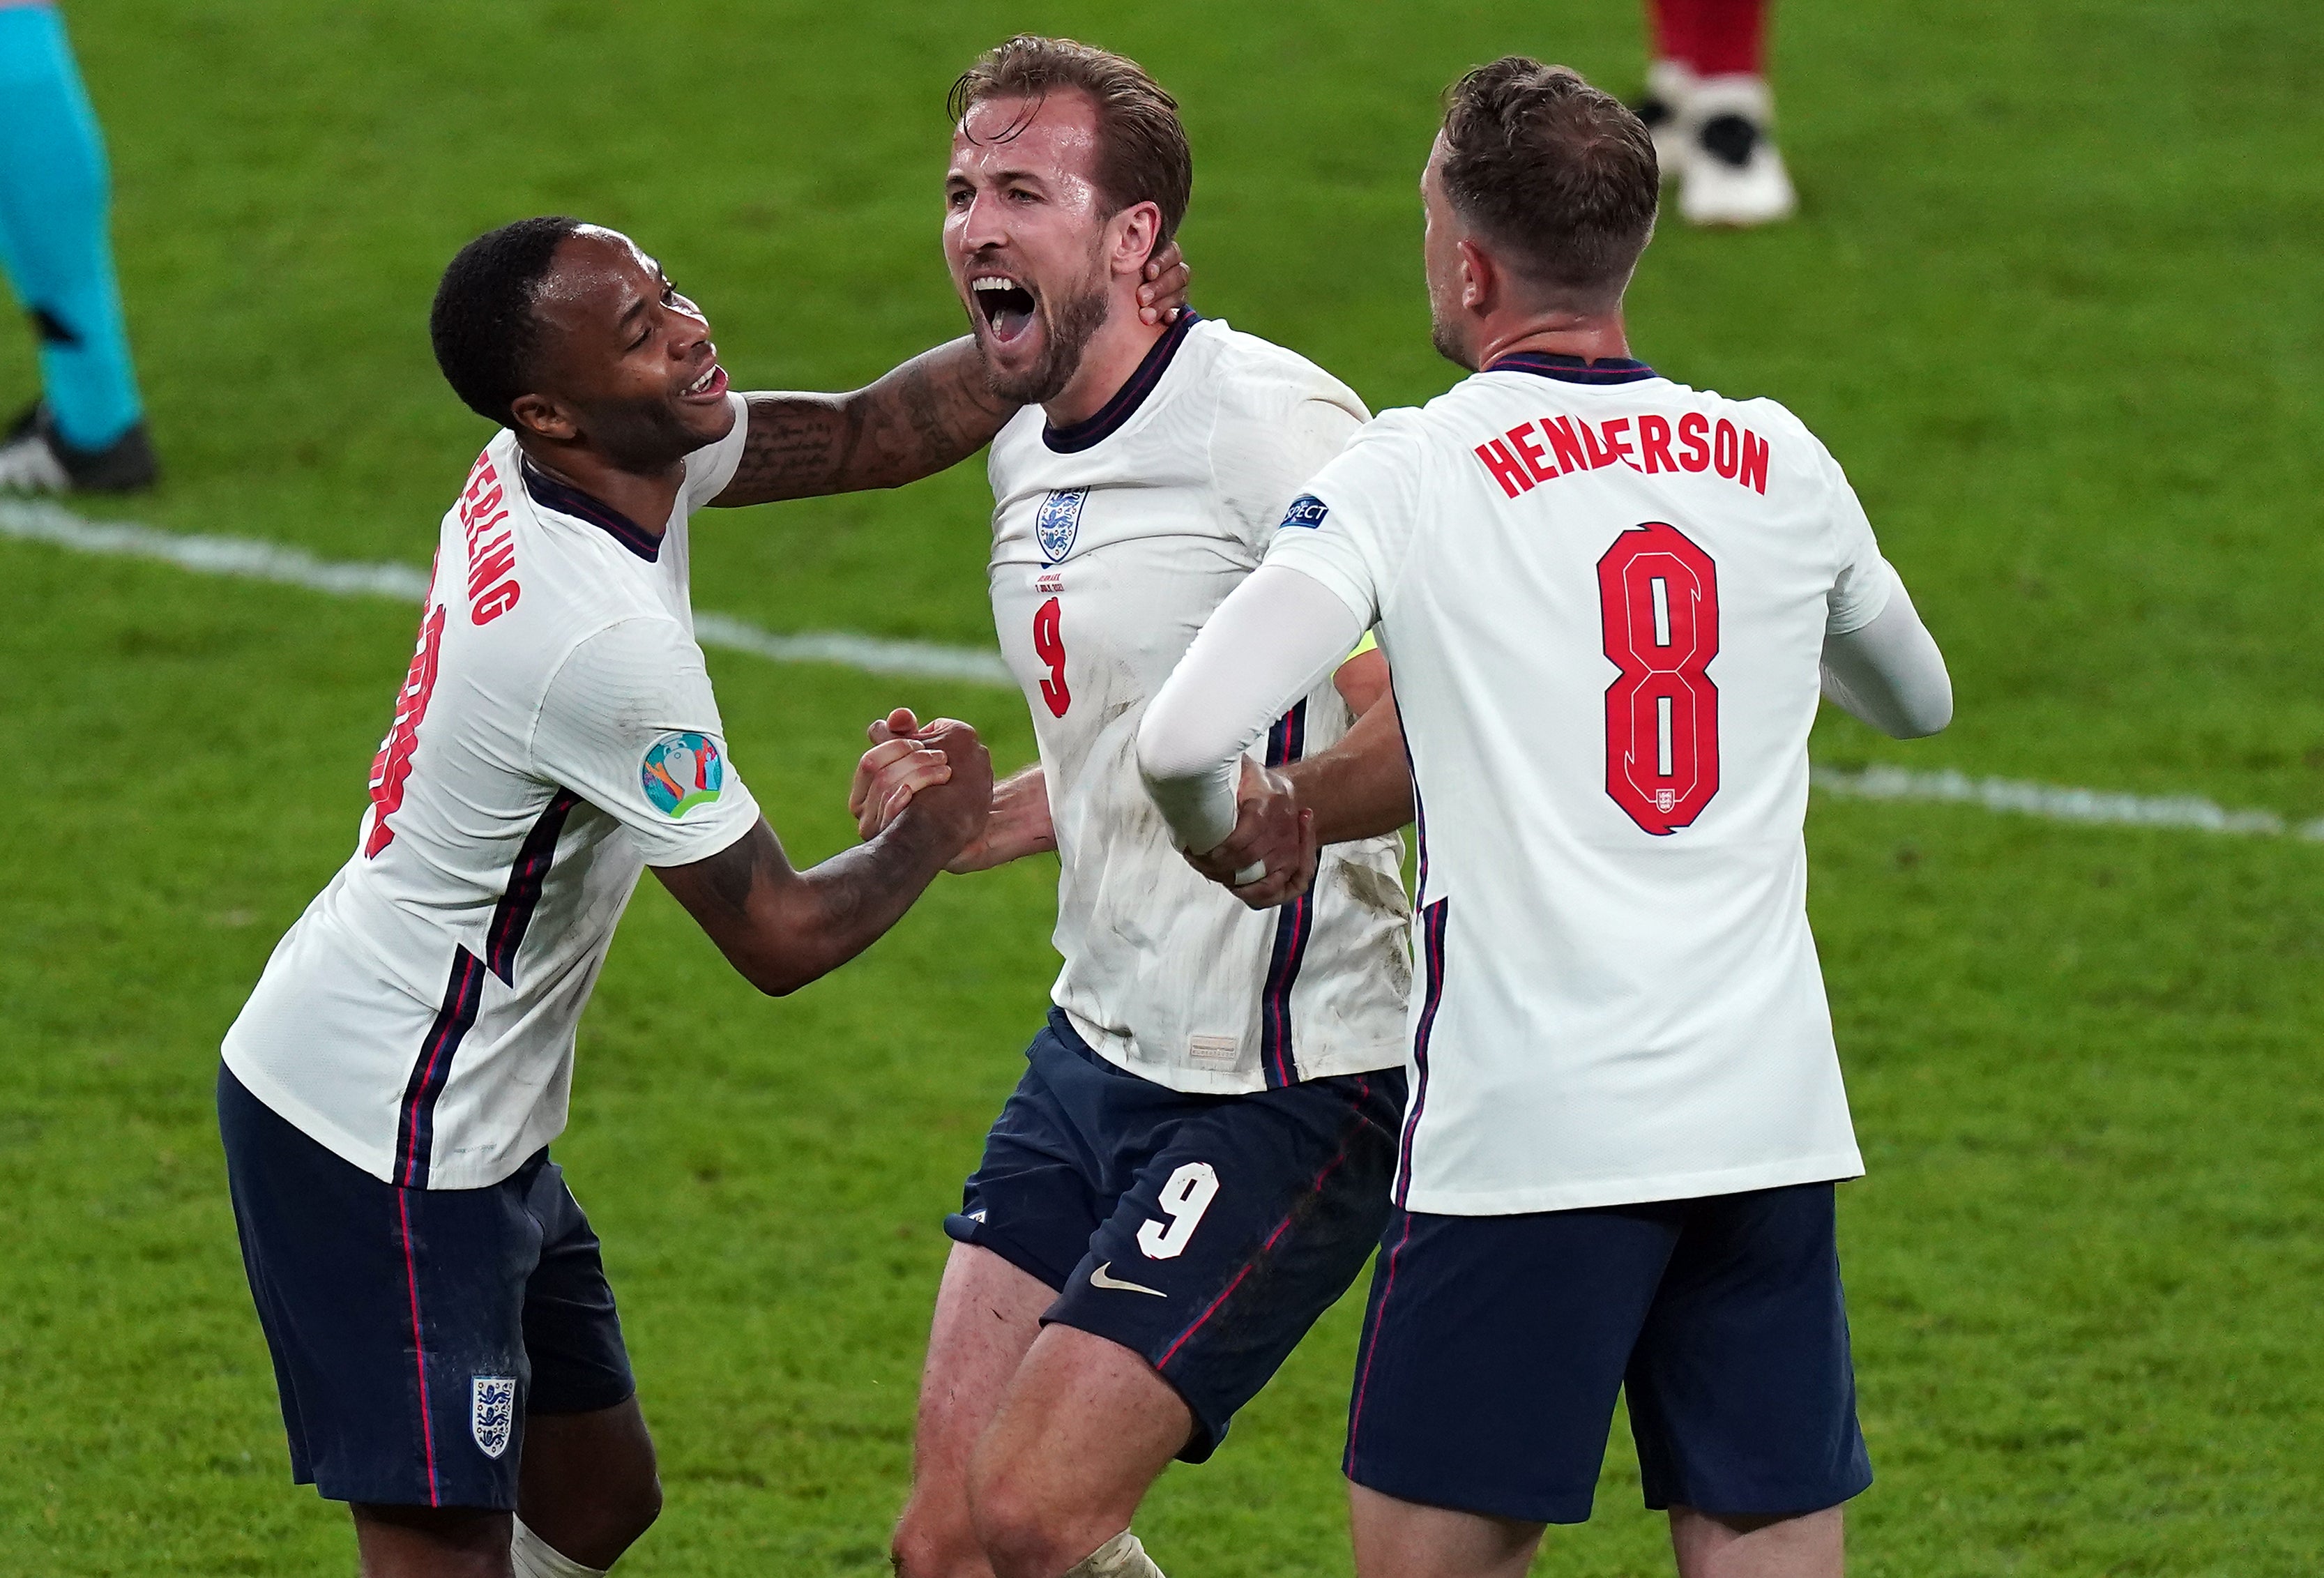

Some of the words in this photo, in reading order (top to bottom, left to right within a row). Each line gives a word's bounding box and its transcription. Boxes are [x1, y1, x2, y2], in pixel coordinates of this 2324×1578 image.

[1473, 411, 1770, 500] HENDERSON
[460, 448, 522, 627] ERLING
[1284, 505, 1328, 520] SPECT
[1033, 596, 1072, 719] 9
[1596, 521, 1719, 837] 8
[1136, 1161, 1220, 1261] 9
